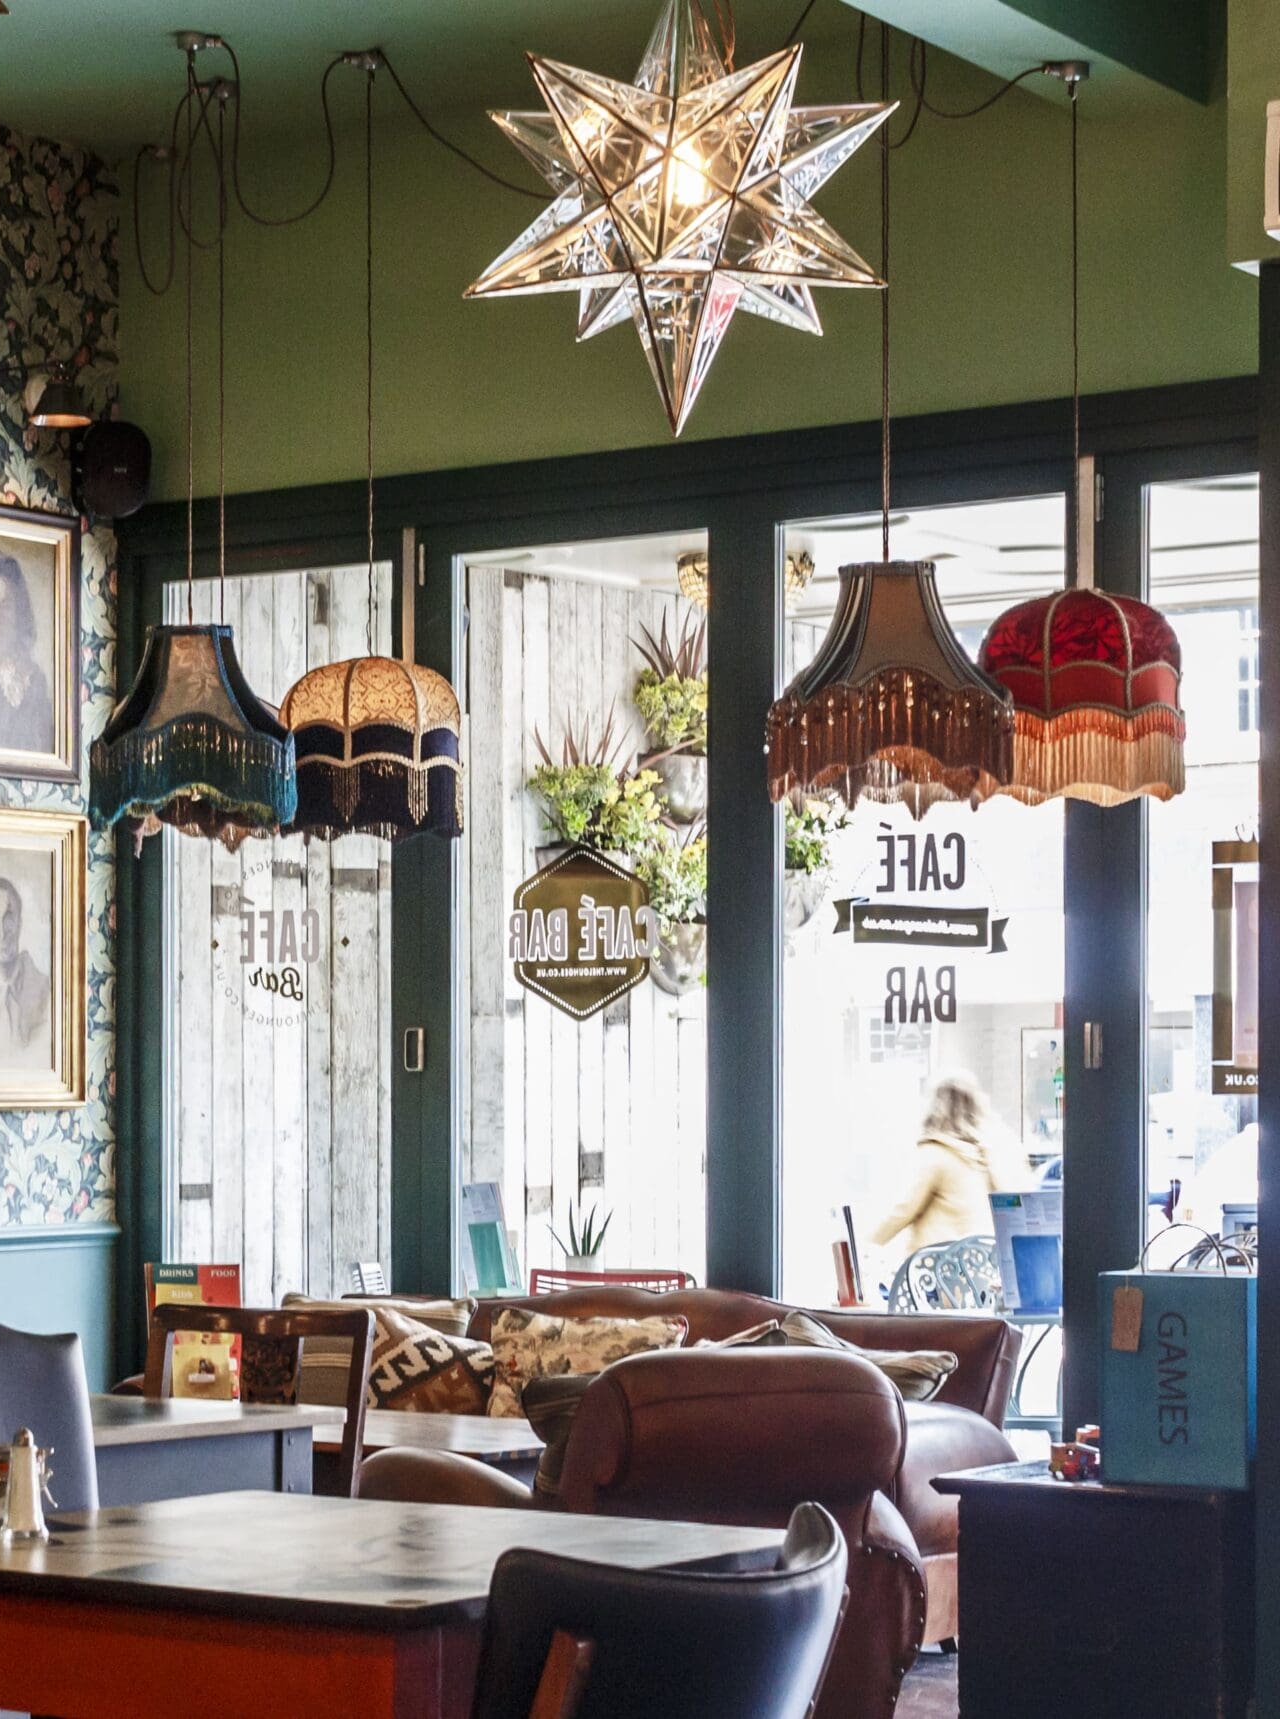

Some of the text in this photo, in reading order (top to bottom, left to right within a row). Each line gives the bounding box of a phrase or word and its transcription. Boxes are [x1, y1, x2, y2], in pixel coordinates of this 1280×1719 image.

[159, 1268, 194, 1278] DRINKS
[210, 1269, 237, 1278] FOOD
[1157, 1310, 1188, 1446] GAMES
